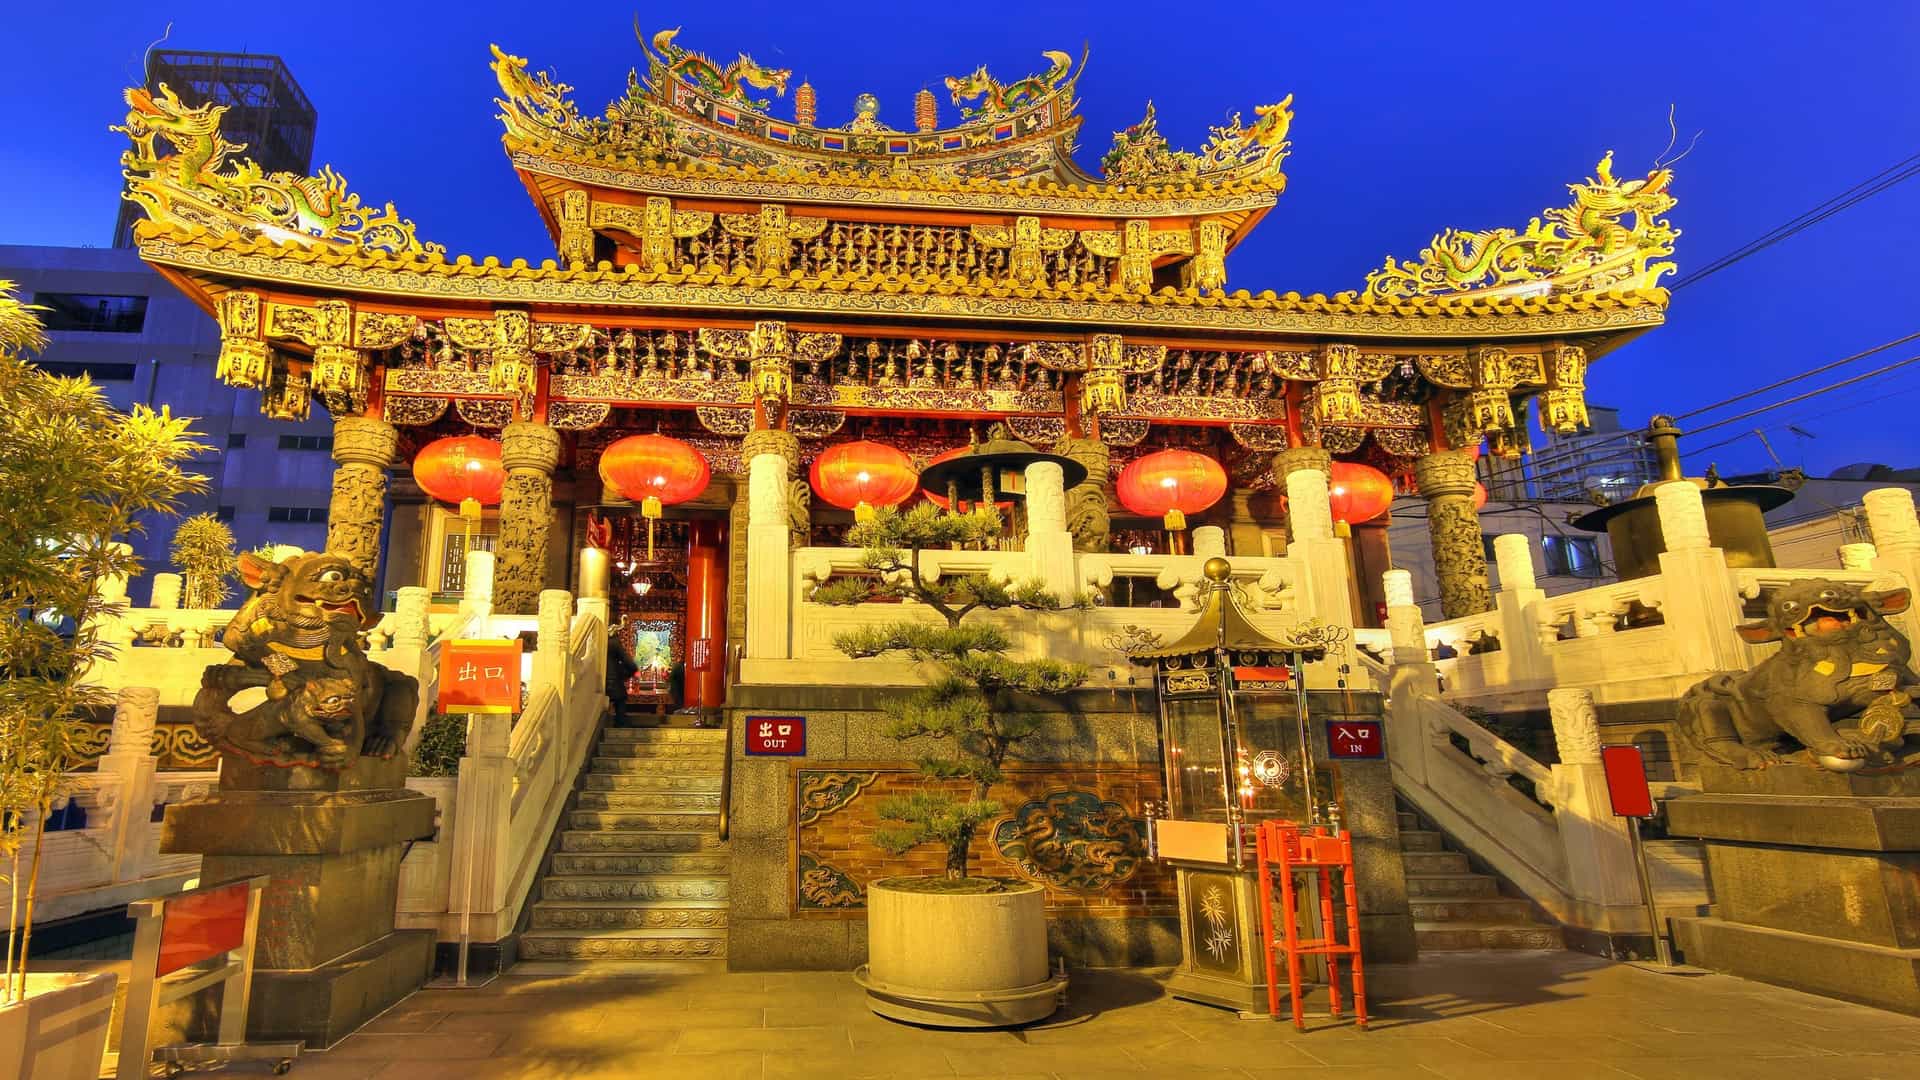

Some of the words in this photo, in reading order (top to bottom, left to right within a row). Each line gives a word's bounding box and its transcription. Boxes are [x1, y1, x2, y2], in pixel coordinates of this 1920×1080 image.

[458, 661, 505, 681] 出口
[759, 722, 792, 737] 出口
[1337, 727, 1369, 740] 入口
[763, 739, 787, 748] OUT
[1350, 744, 1362, 752] IN
